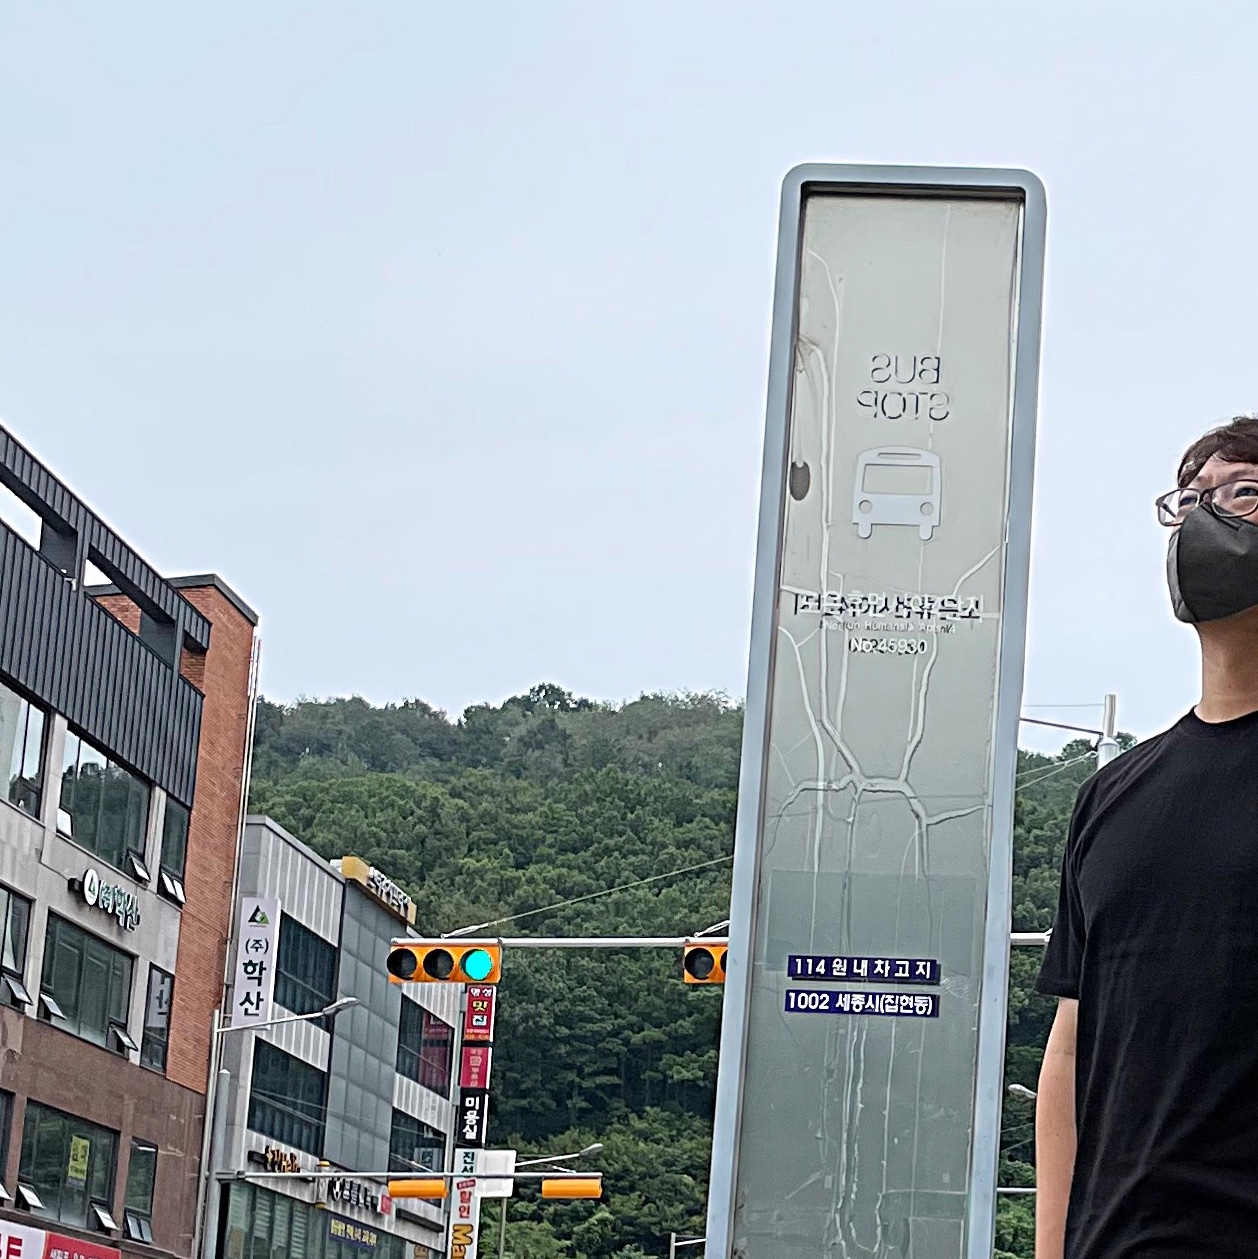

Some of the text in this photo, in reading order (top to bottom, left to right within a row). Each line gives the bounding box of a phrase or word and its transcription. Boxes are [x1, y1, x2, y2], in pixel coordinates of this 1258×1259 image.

[795, 957, 826, 975] 114
[239, 959, 267, 1017] 학산
[788, 991, 933, 1016] 1002 세종시(집현동)
[462, 1096, 480, 1140] 미용실
